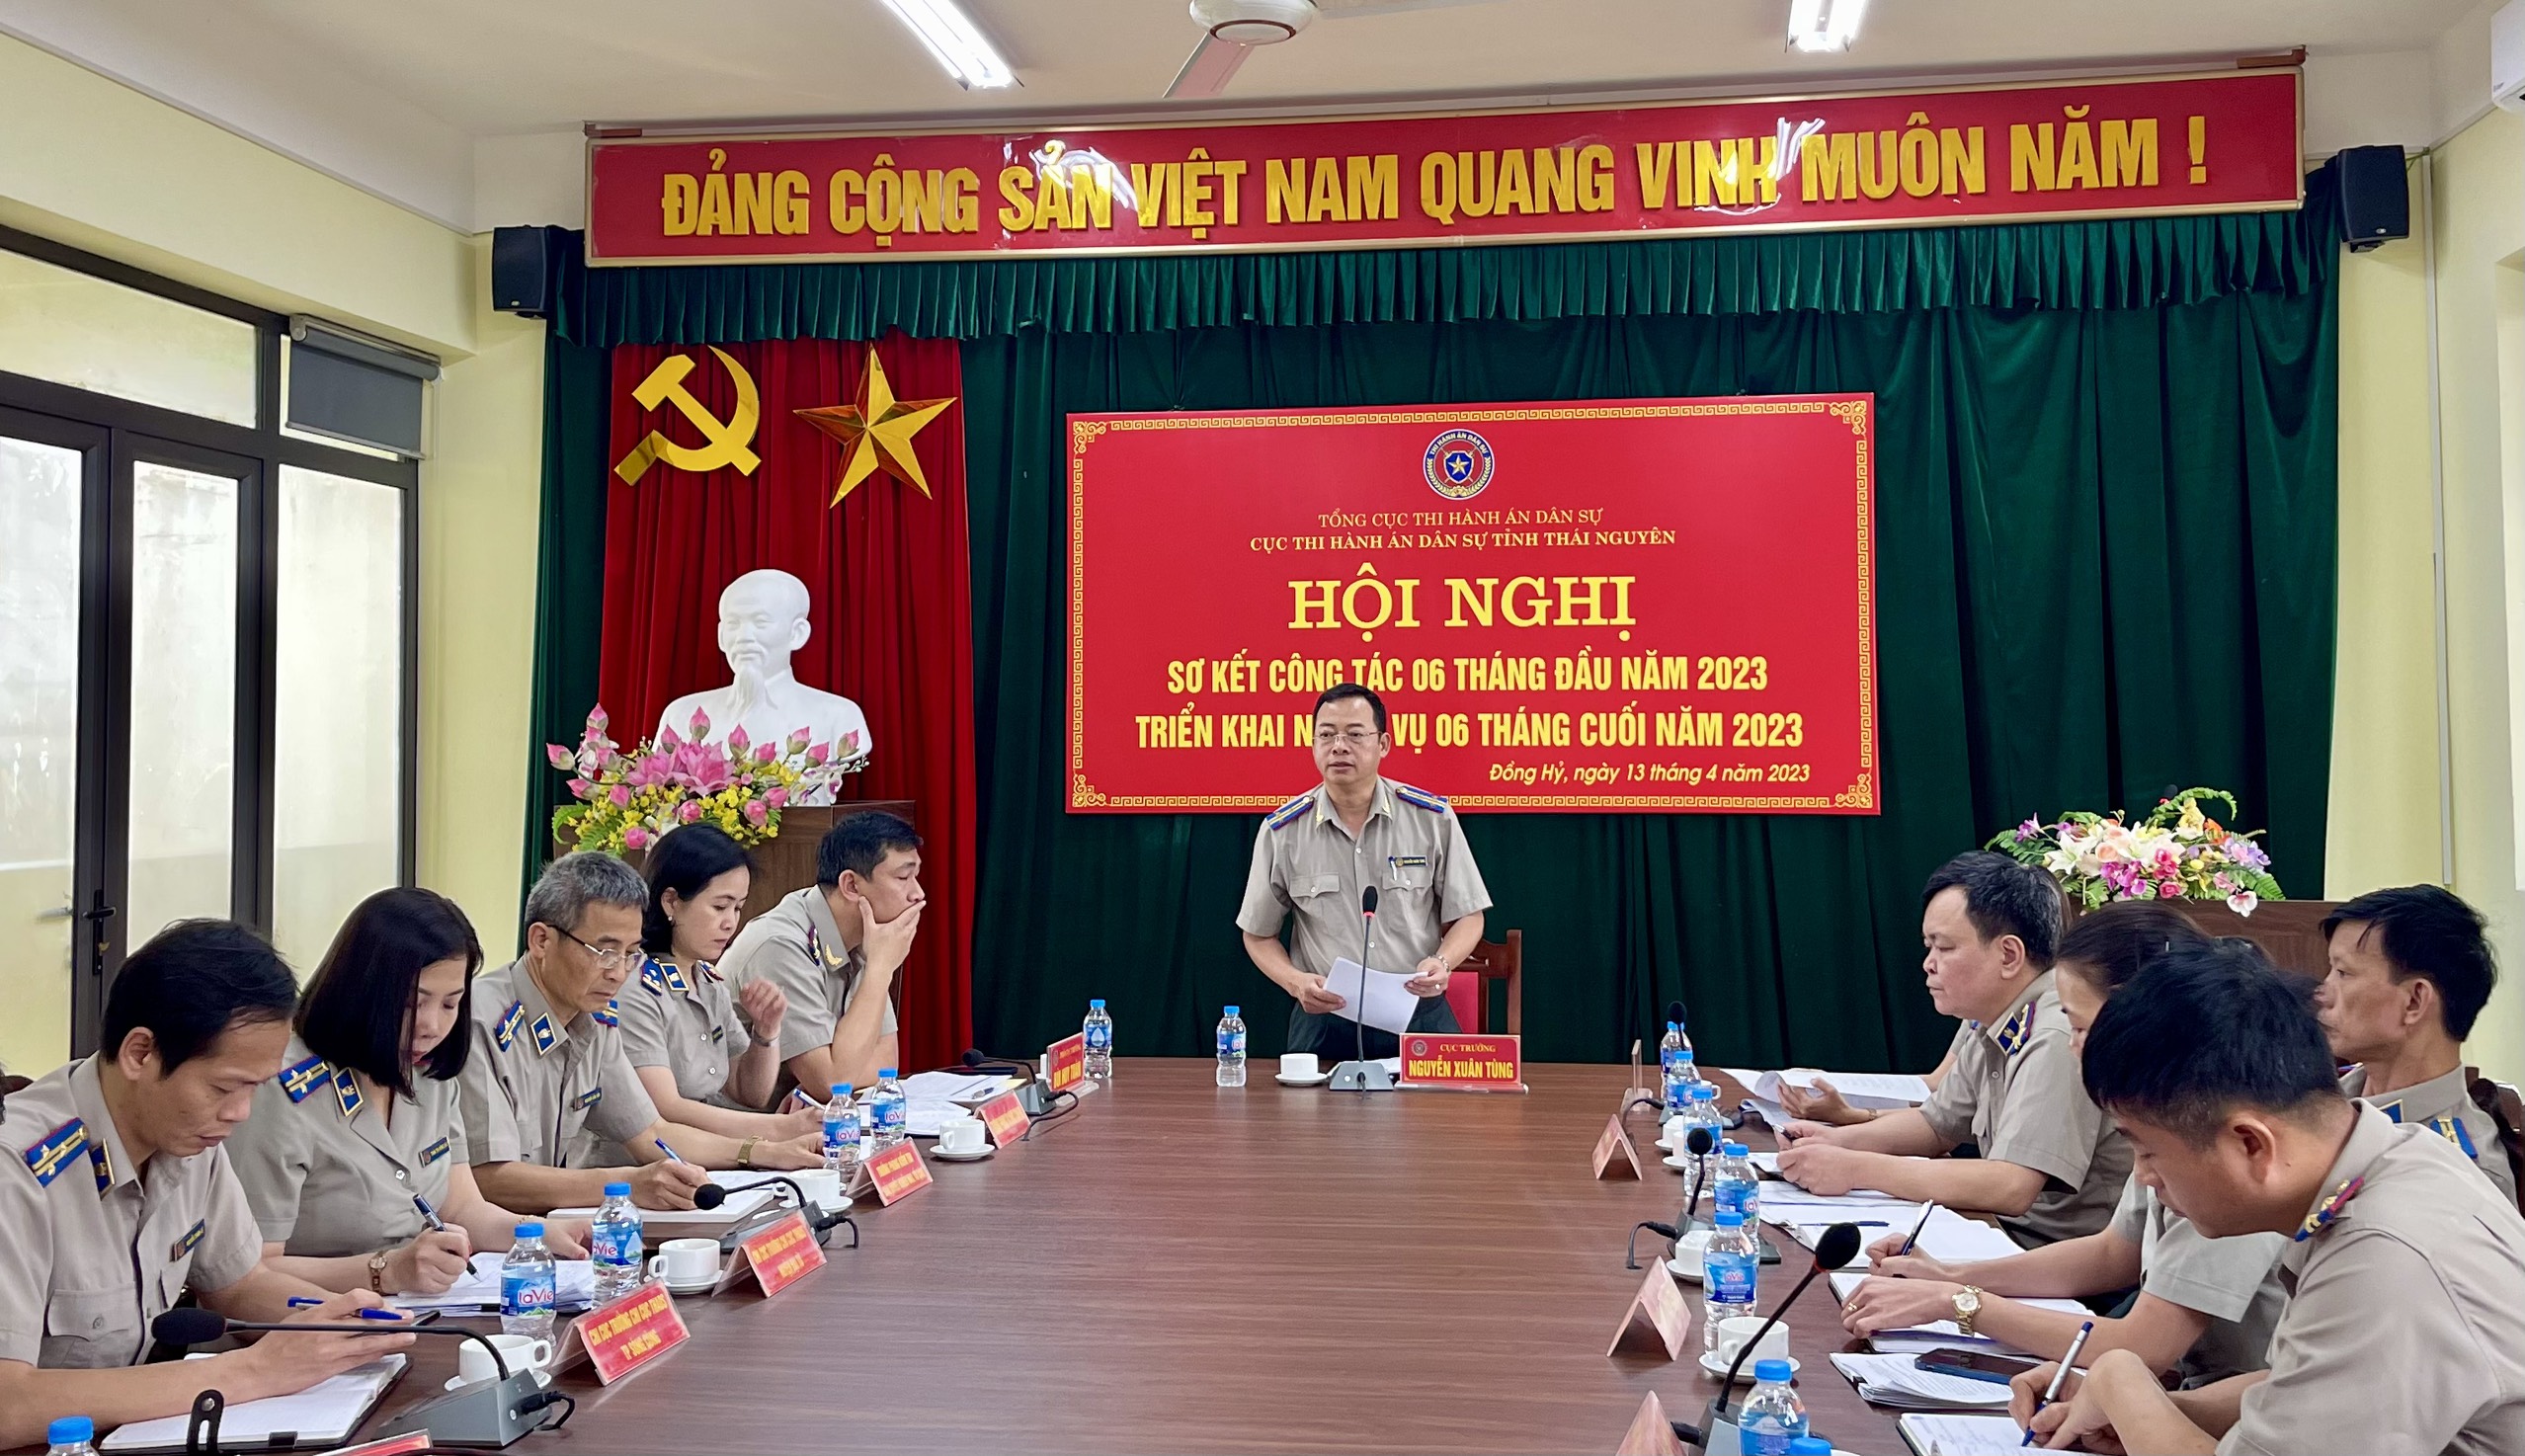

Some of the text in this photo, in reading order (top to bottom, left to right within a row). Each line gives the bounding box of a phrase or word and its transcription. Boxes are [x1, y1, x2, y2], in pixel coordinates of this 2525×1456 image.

[662, 104, 2208, 246] ĐẢNG CỘNG SẢN VIỆT NAM QUANG VINH MUÔN NĂM !
[1318, 507, 1604, 529] TỔNG CỤC THI HÀNH ÁN DÂN SỰ
[1250, 526, 1676, 554] CỤC THI HÀNH ÁN DÂN SỰ TỈNH THÁI NGUYÊN
[1287, 562, 1637, 642] HỘI NGHỊ
[1167, 645, 1768, 693] SƠ KẾT CÔNG TÁC 06 THÁNG ĐẦU NĂM 2023
[1135, 701, 1213, 749] TRIỂN
[1221, 714, 1285, 748] KHAI
[1391, 712, 1427, 755] VỤ
[1435, 713, 1470, 747] 06
[1477, 705, 1571, 747] THÁNG
[1580, 700, 1646, 747] CUỐI
[1655, 705, 1723, 747] NĂM
[1732, 712, 1803, 748] 2023
[1489, 760, 1811, 786] Đồng Hỷ, ngày 13 tháng 4 năm 2023
[1439, 1042, 1497, 1054] CỤC TRƯỞNG
[1408, 1054, 1514, 1080] NGUYỄN XUÂN TÙNG
